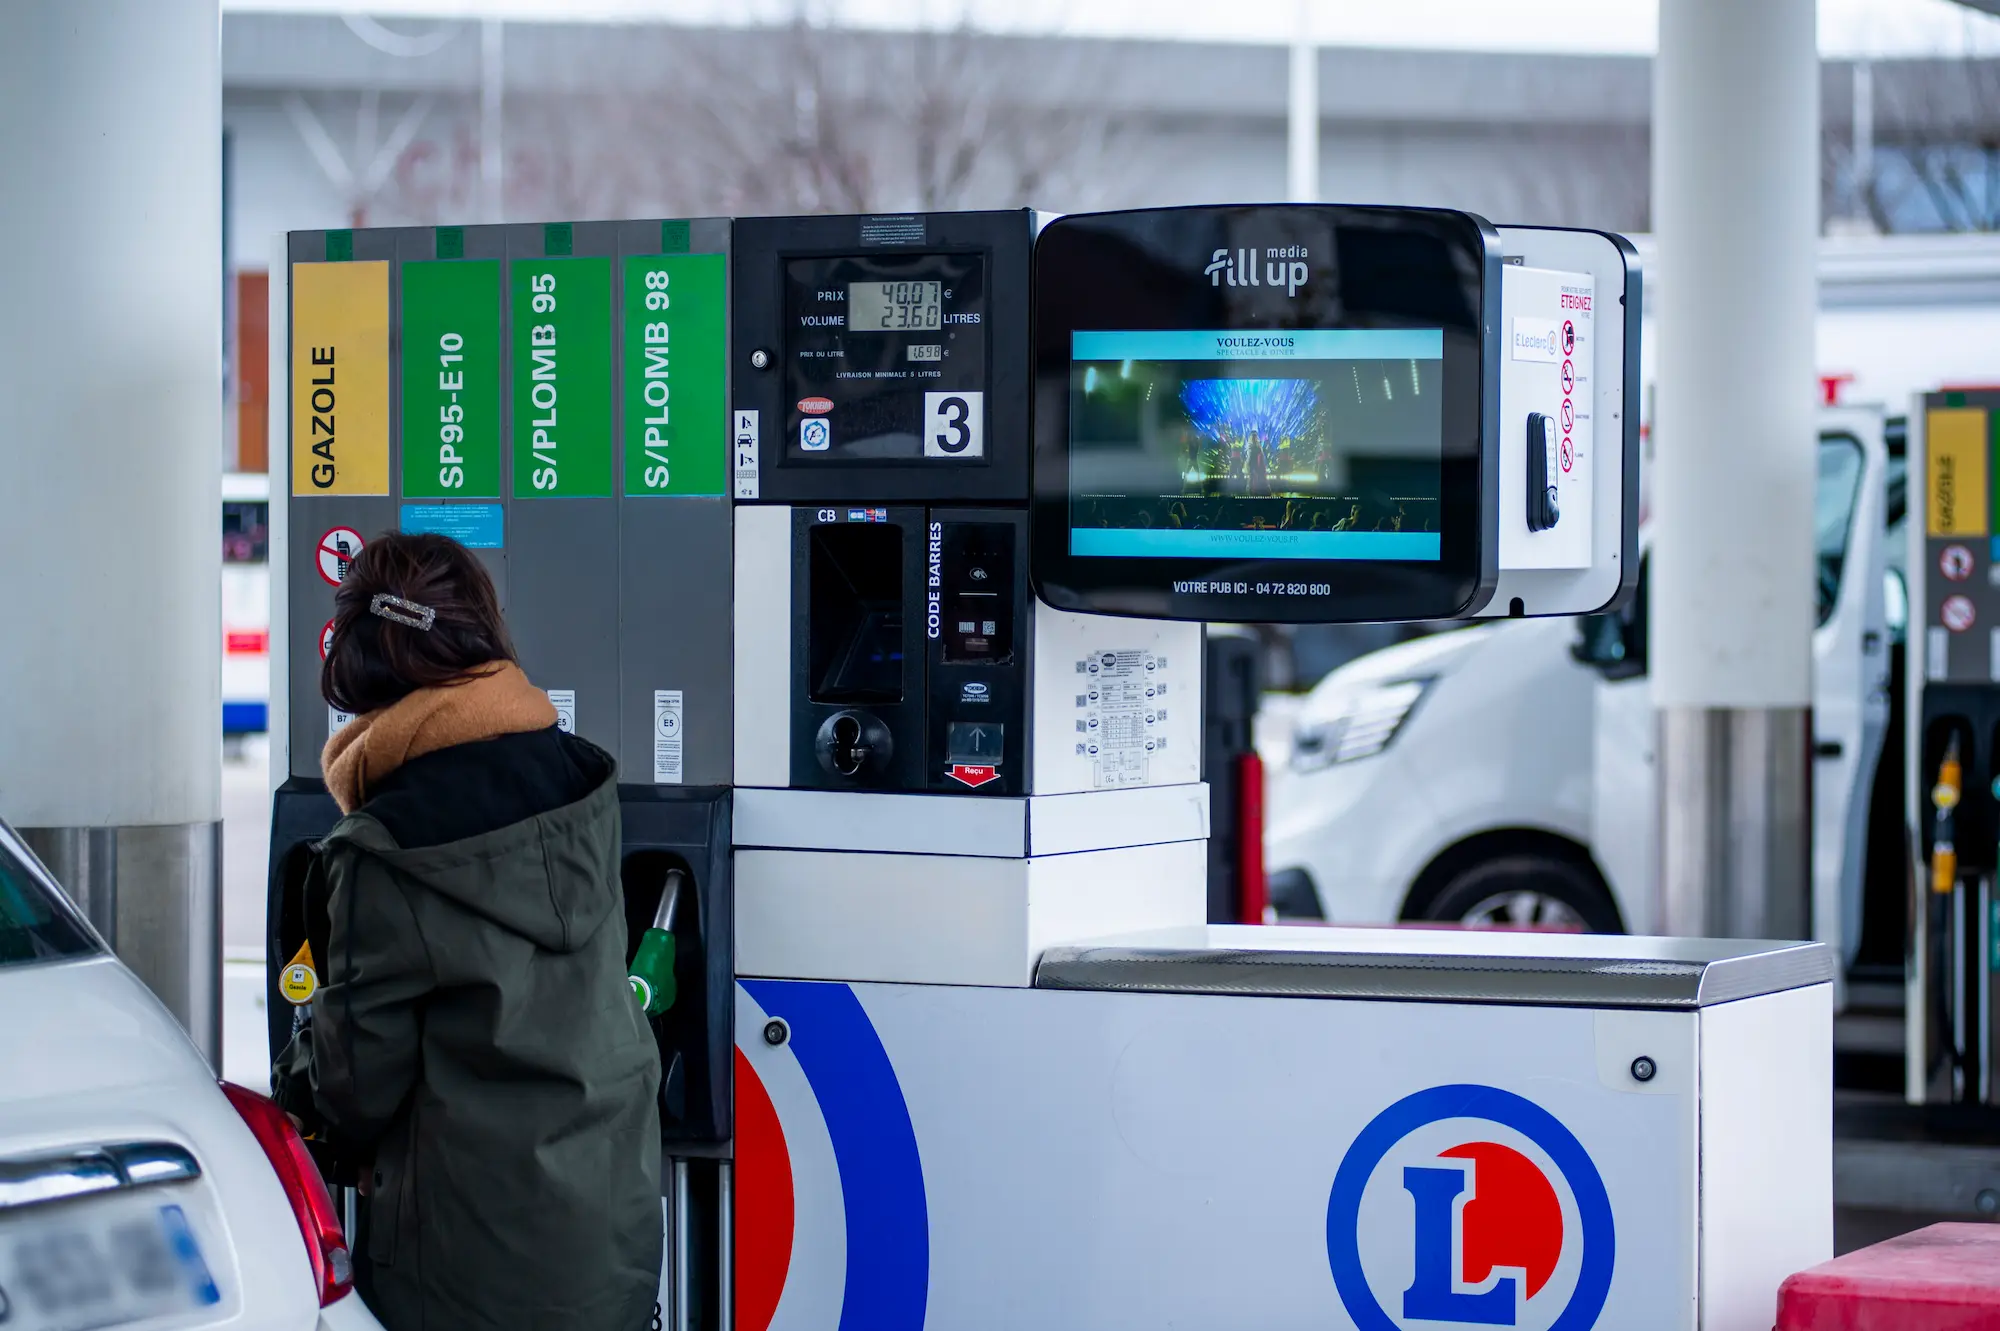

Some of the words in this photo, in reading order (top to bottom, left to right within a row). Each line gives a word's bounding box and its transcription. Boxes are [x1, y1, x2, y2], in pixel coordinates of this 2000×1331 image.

[1267, 245, 1308, 258] media
[1204, 248, 1260, 287] fill
[1266, 262, 1309, 297] up
[532, 273, 556, 313] 95
[645, 270, 670, 310] 98
[817, 291, 844, 301] PRIX
[882, 282, 938, 305] 40,07
[943, 288, 953, 299] €
[1561, 294, 1592, 311] ETEIGNEZ
[801, 315, 845, 326] VOLUME
[881, 305, 938, 328] 23,60
[943, 313, 981, 324] LITRES
[1217, 338, 1294, 348] VOULEZ-VOUS
[1515, 333, 1547, 350] E.Leclerc
[827, 350, 845, 358] LITRE
[1216, 348, 1259, 356] SPECTACLE
[836, 371, 872, 379] LIVRAISON
[439, 332, 465, 489] SP95-E10
[532, 323, 558, 490] S/PLOMB
[644, 321, 670, 489] S/PLOMB
[311, 345, 336, 489] GAZOLE
[937, 396, 971, 453] 3
[817, 509, 837, 522] CB
[928, 522, 942, 588] BARRES
[1173, 581, 1208, 594] VOTRE
[1210, 582, 1232, 594] PUB
[1234, 582, 1248, 594] ICI
[1256, 582, 1271, 595] 04
[1272, 583, 1285, 595] 72
[1287, 583, 1307, 595] 820
[1309, 583, 1331, 596] 800
[928, 591, 941, 638] CODE
[337, 714, 347, 723] B7
[557, 718, 567, 726] E5
[663, 719, 674, 727] E5
[964, 766, 984, 776] Reçu
